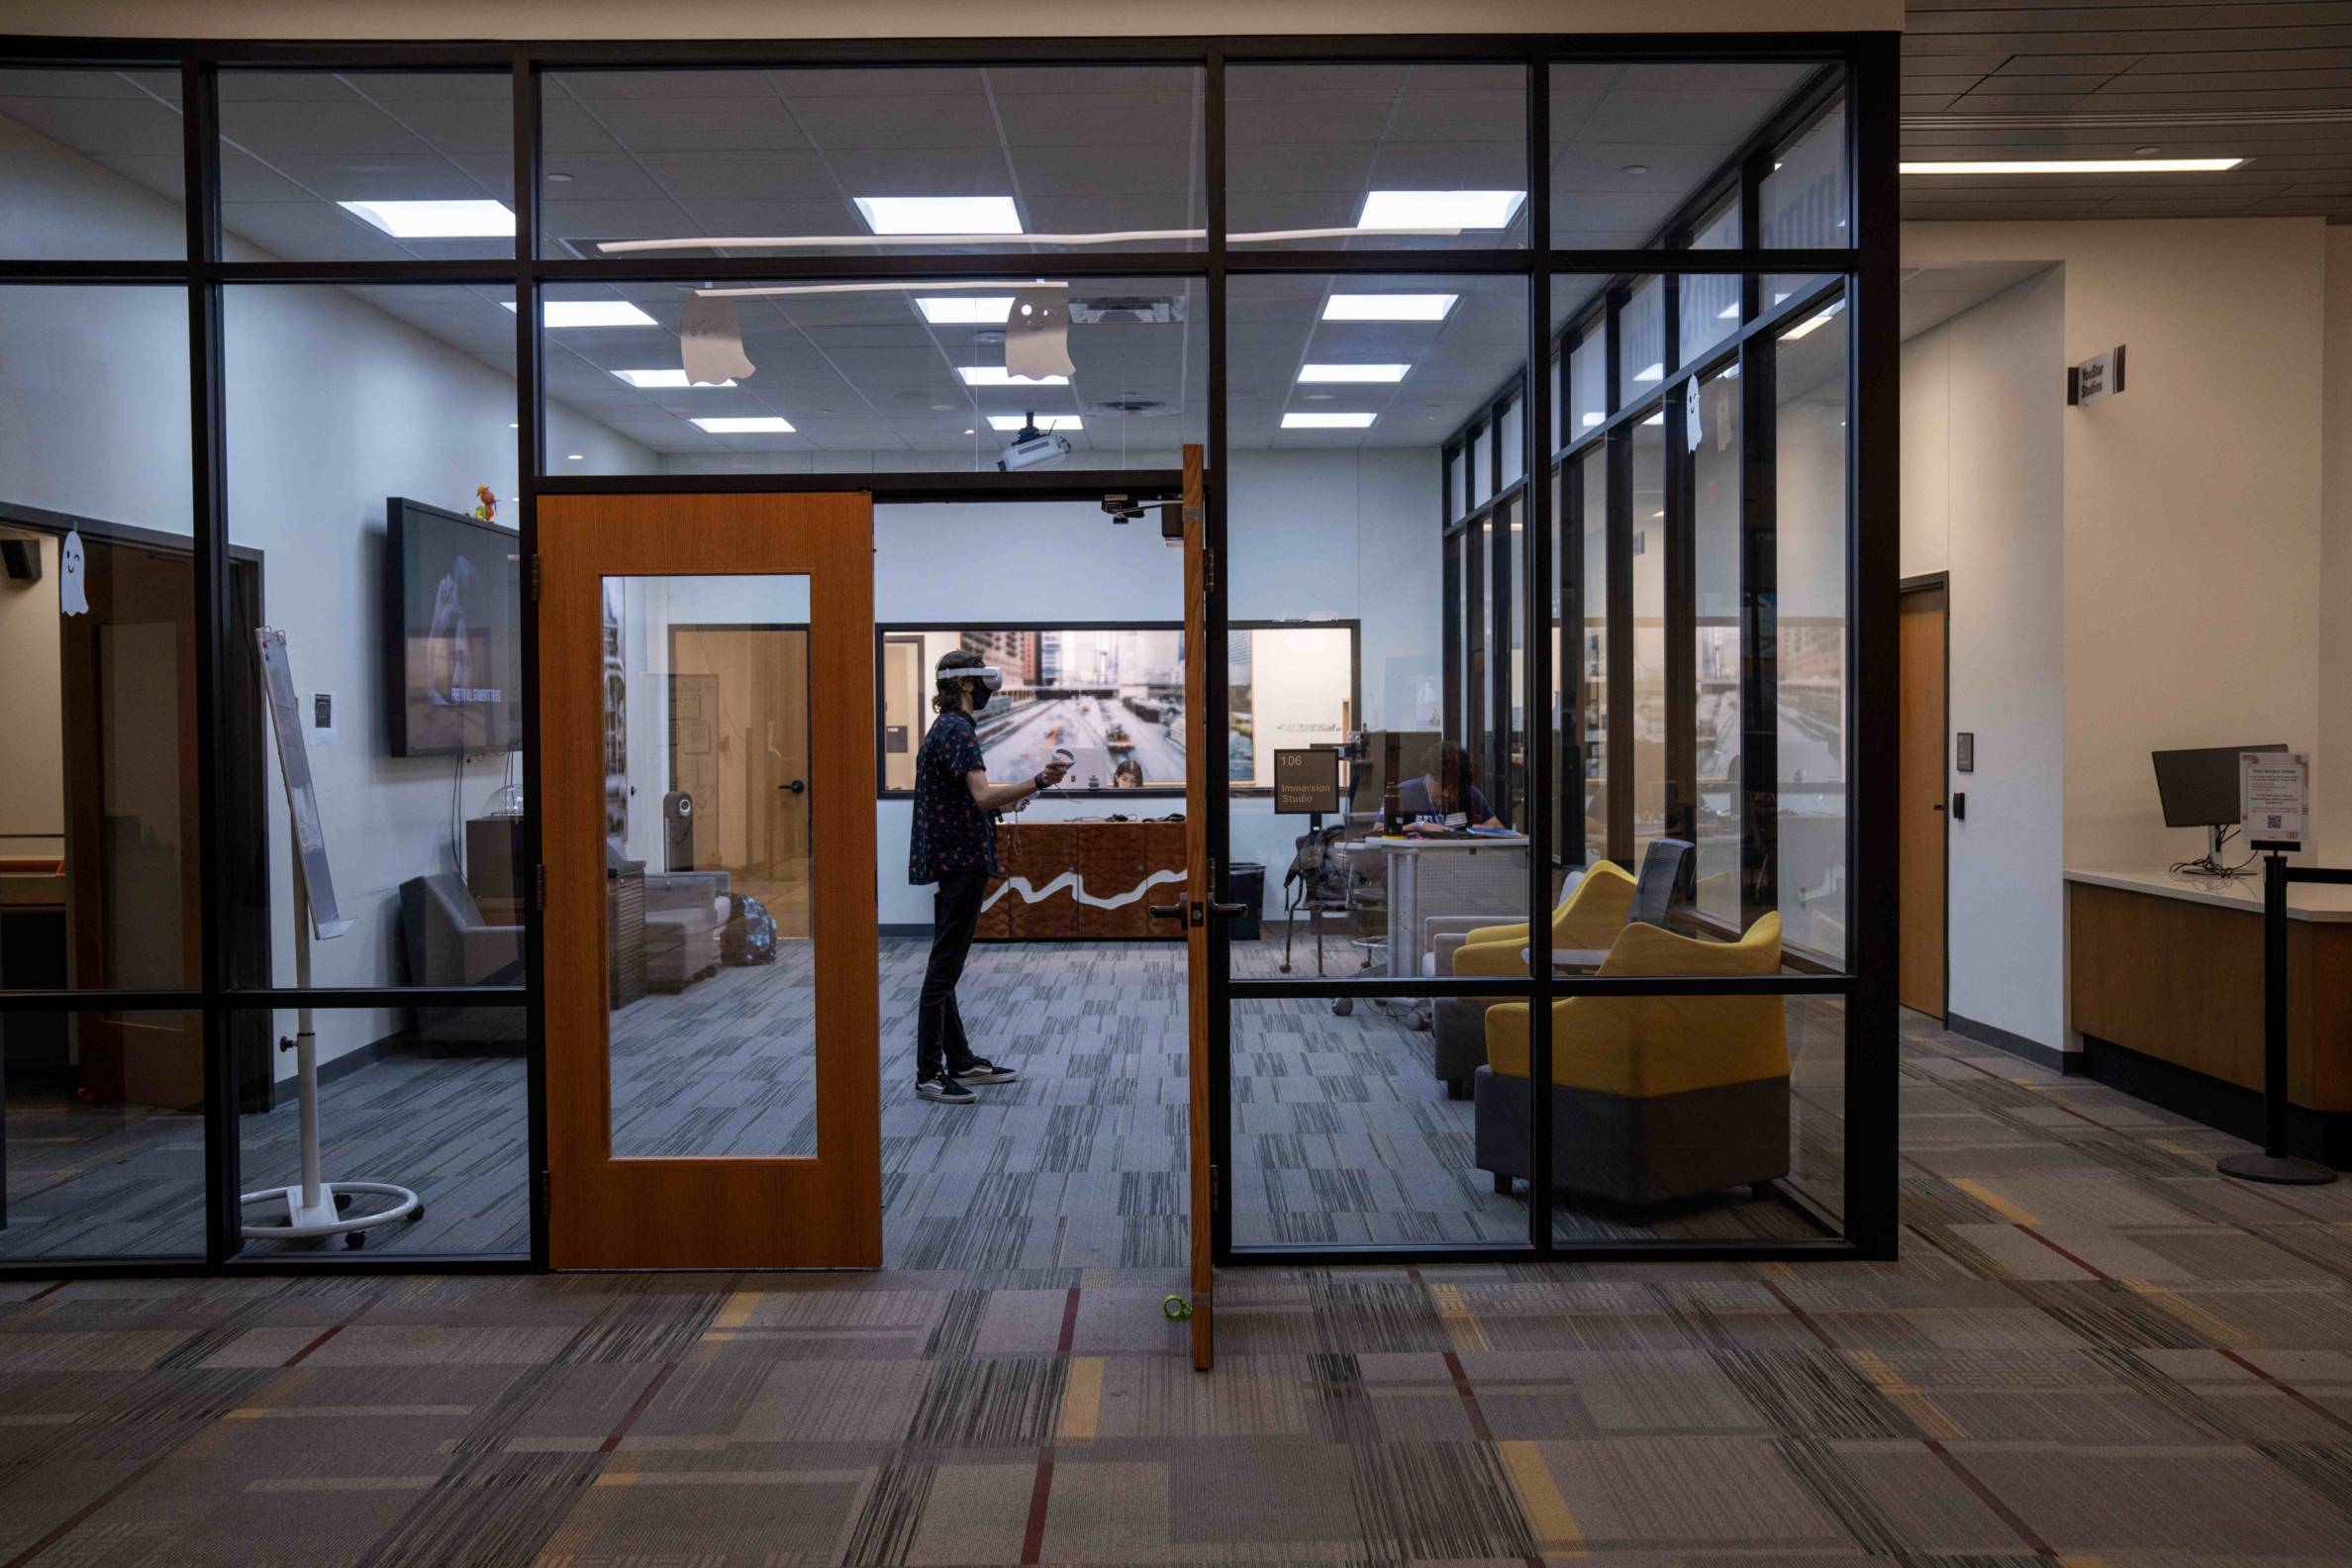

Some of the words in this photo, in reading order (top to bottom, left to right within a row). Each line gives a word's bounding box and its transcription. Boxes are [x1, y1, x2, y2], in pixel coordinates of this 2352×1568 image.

[1282, 755, 1303, 766] 106
[1282, 784, 1330, 793] Immersion
[1282, 794, 1314, 803] Studio
